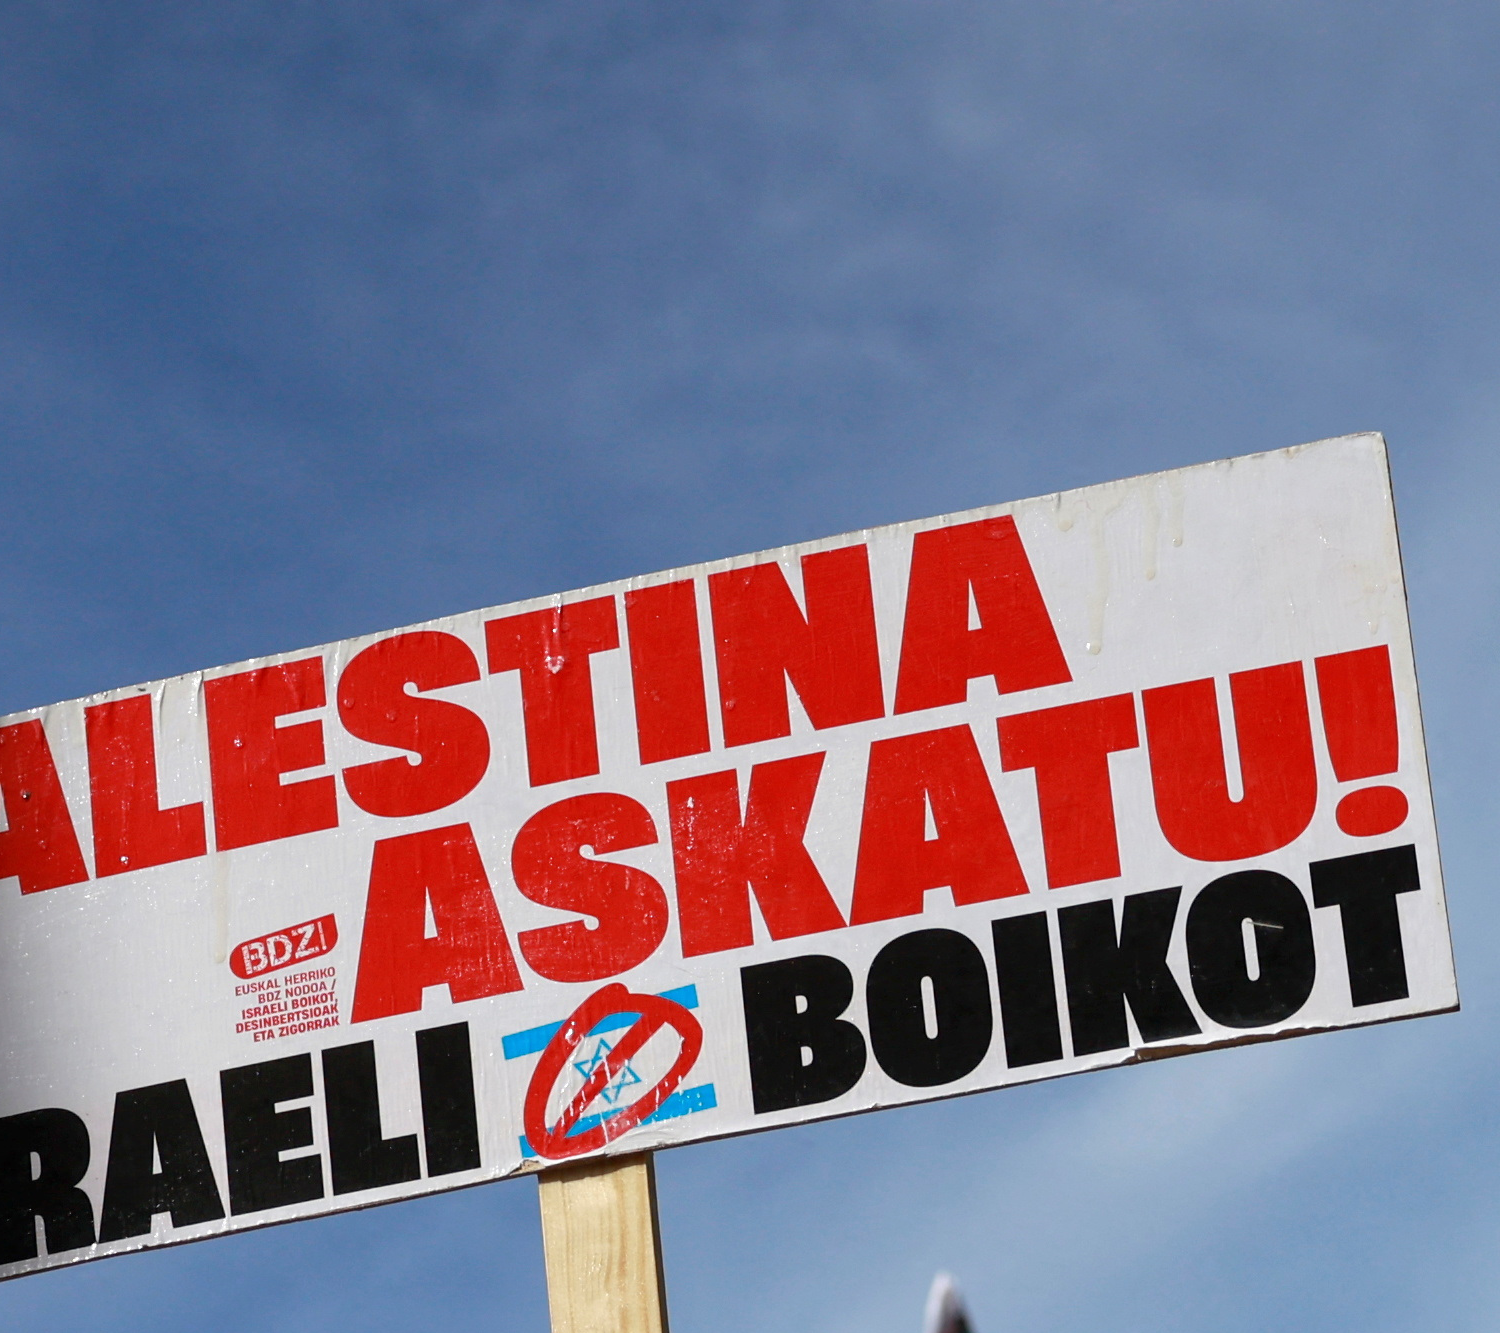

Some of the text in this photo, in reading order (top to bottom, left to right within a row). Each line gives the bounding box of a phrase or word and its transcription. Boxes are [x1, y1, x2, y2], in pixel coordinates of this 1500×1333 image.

[350, 645, 1410, 1024] ASKATU!
[241, 920, 327, 976] BDZ!
[235, 966, 336, 997] EUSKAL HERRIKO
[258, 990, 281, 1004] BDZ
[285, 981, 328, 999] NODOA
[740, 844, 1421, 1114] BOIKOT
[236, 1004, 339, 1034] DESINBERTSIOAK
[241, 991, 338, 1020] ISRAELI BOIKOT,
[253, 1015, 340, 1043] ETA ZIGORRAK
